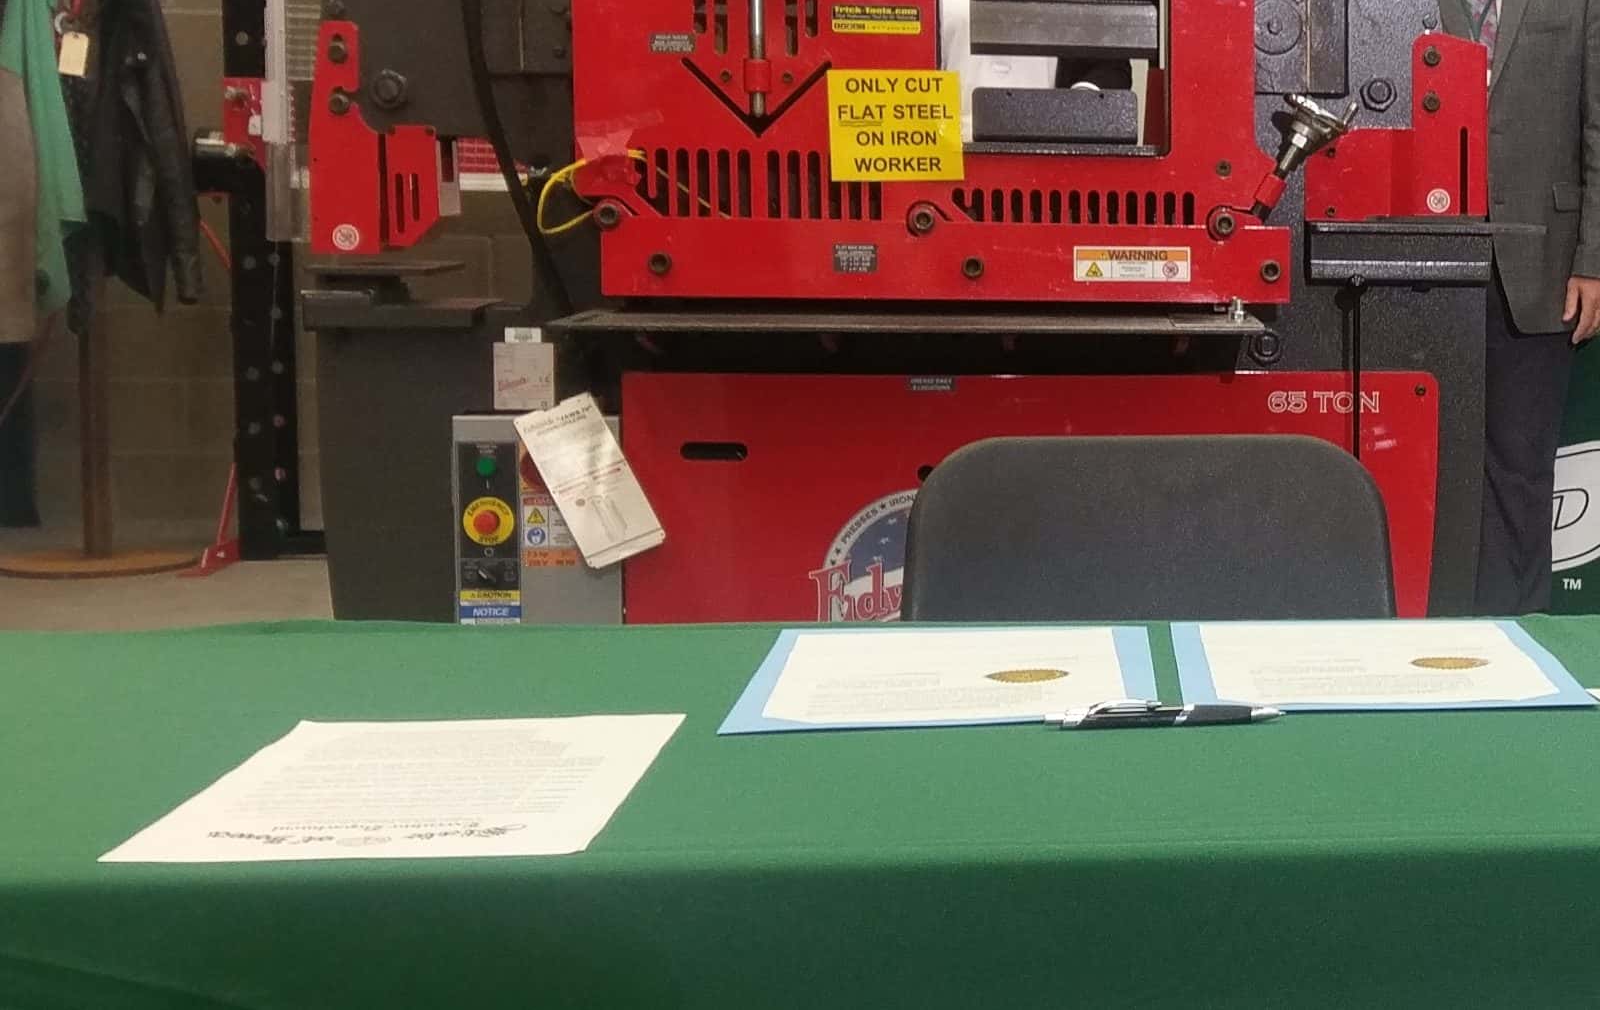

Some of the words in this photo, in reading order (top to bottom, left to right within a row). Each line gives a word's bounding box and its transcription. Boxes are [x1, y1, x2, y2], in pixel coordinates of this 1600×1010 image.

[845, 78, 899, 94] ONLY
[905, 78, 943, 93] CUT
[838, 105, 885, 120] FLAT
[894, 104, 953, 120] STEEL
[857, 131, 886, 146] ON
[891, 130, 937, 146] IRON
[855, 157, 942, 172] WORKER
[1108, 249, 1168, 261] WARNING
[1267, 391, 1308, 413] 65
[1313, 391, 1380, 413] TON
[1562, 578, 1582, 590] TM
[472, 607, 510, 617] NOTICE
